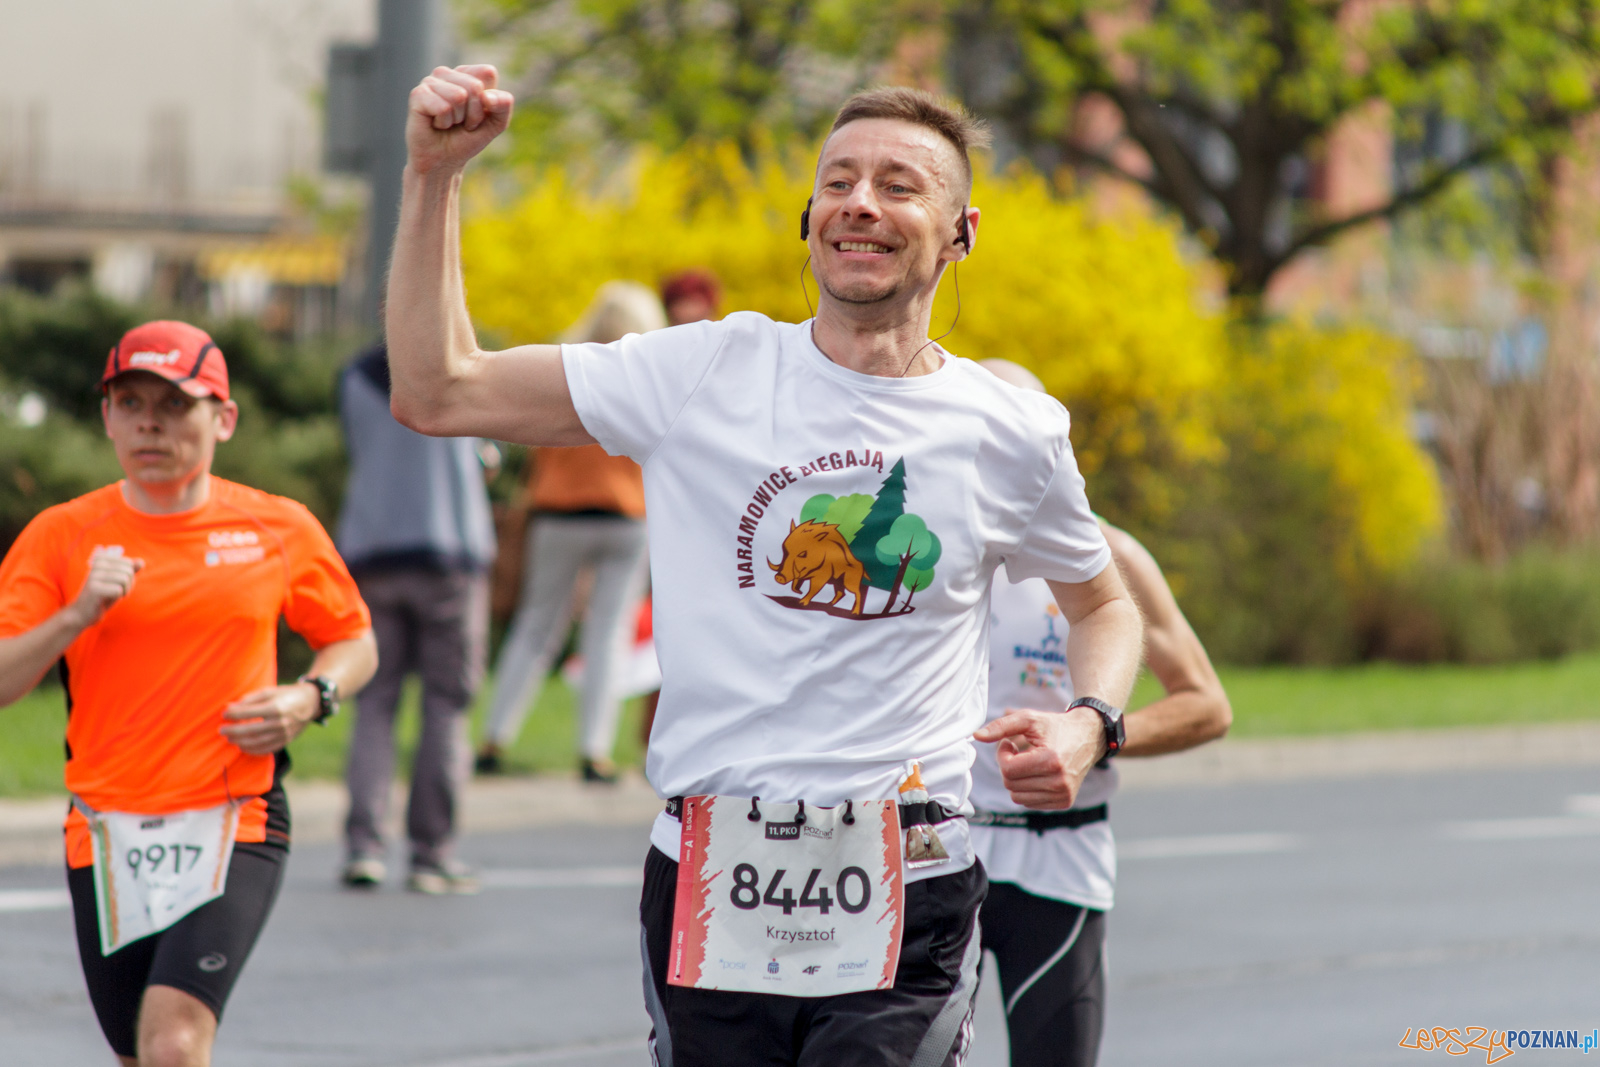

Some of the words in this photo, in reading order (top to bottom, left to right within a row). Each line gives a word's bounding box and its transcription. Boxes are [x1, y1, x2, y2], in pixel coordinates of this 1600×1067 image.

[737, 465, 798, 589] NARAMOWICE
[798, 449, 884, 478] BIEGAJĄ
[768, 826, 779, 836] 11.
[780, 826, 798, 836] PKO
[684, 840, 694, 848] A
[127, 843, 203, 879] 9917
[730, 863, 871, 915] 8440
[766, 925, 836, 943] Krzysztof
[802, 965, 821, 975] 4F
